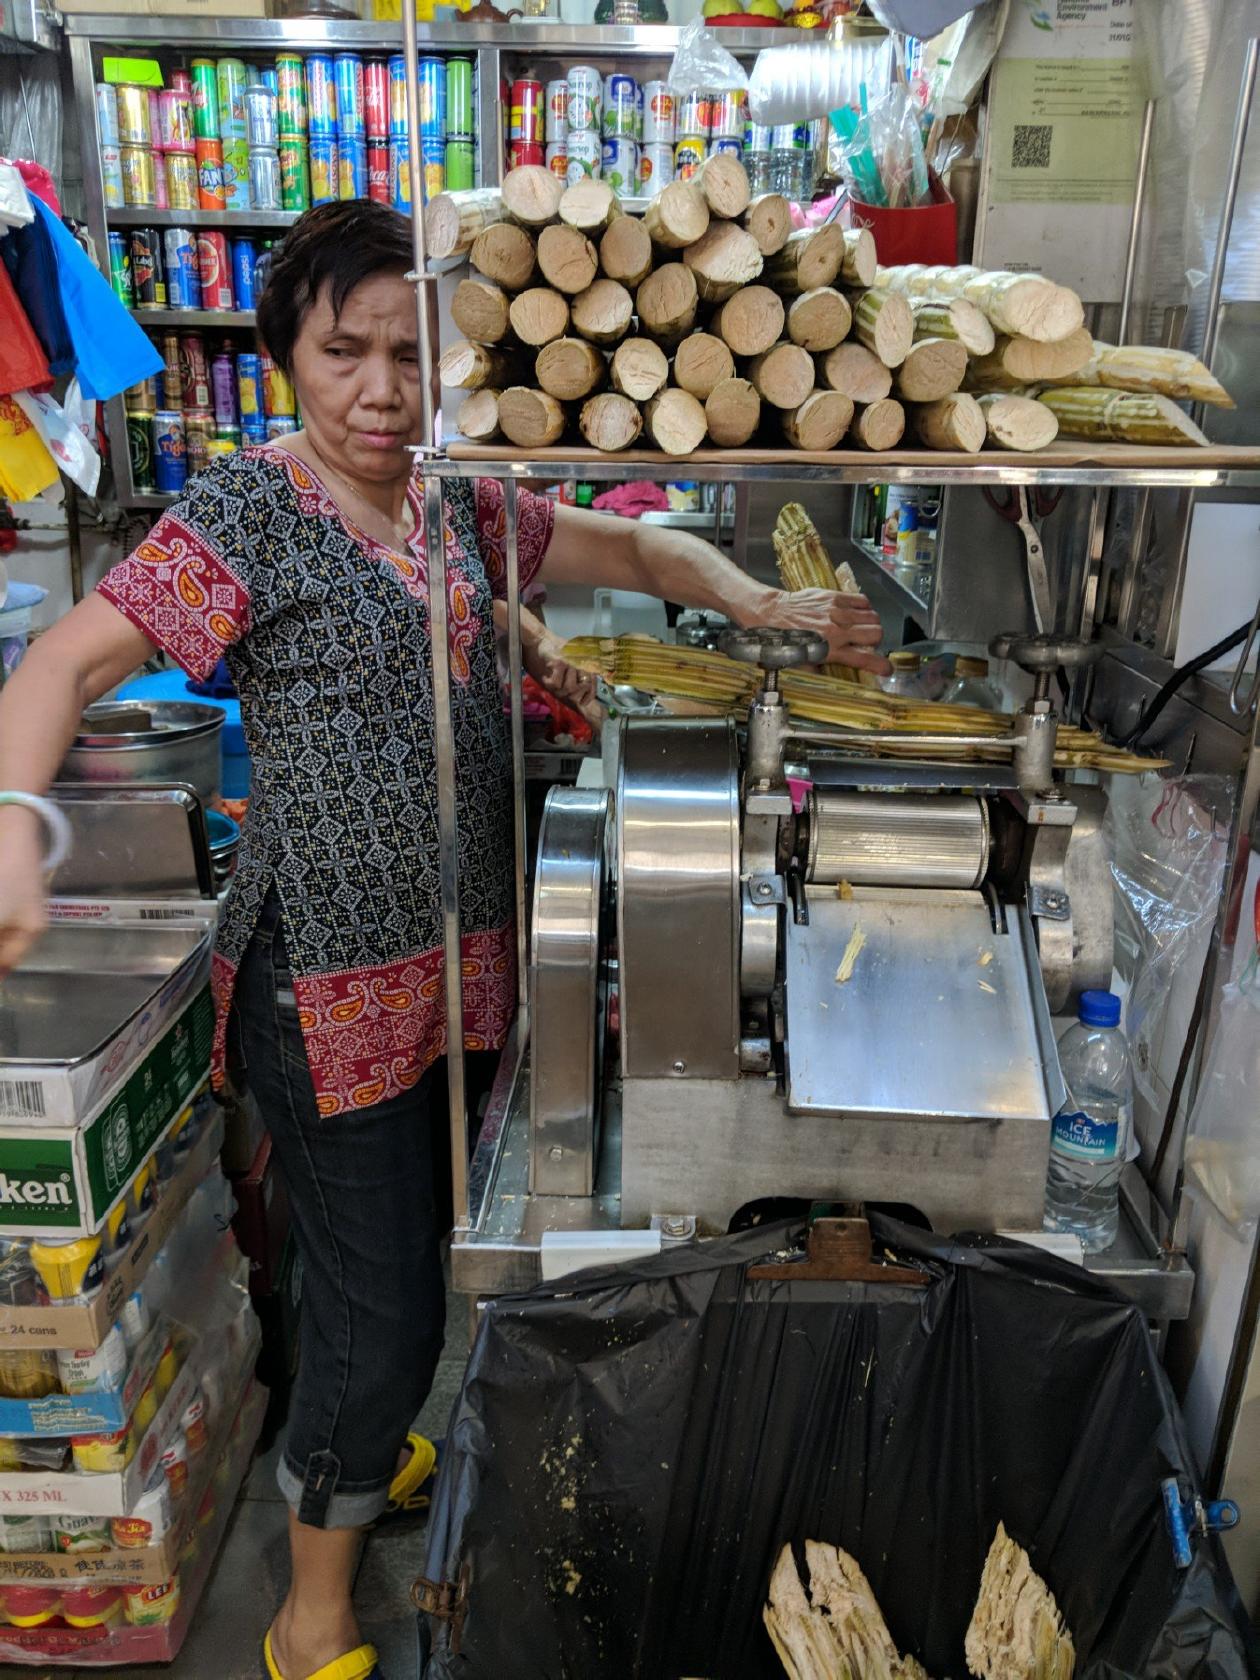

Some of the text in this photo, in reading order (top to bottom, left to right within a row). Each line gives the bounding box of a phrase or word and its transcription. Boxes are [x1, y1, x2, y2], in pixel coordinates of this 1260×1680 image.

[1057, 12, 1087, 21] Agency
[241, 255, 253, 285] pepsi
[1070, 1122, 1092, 1136] ICE
[1056, 1127, 1106, 1146] MOUNTAIN
[11, 1325, 26, 1335] 24
[3, 1491, 12, 1502] X
[17, 1491, 39, 1502] 325
[148, 1583, 169, 1600] LEE
